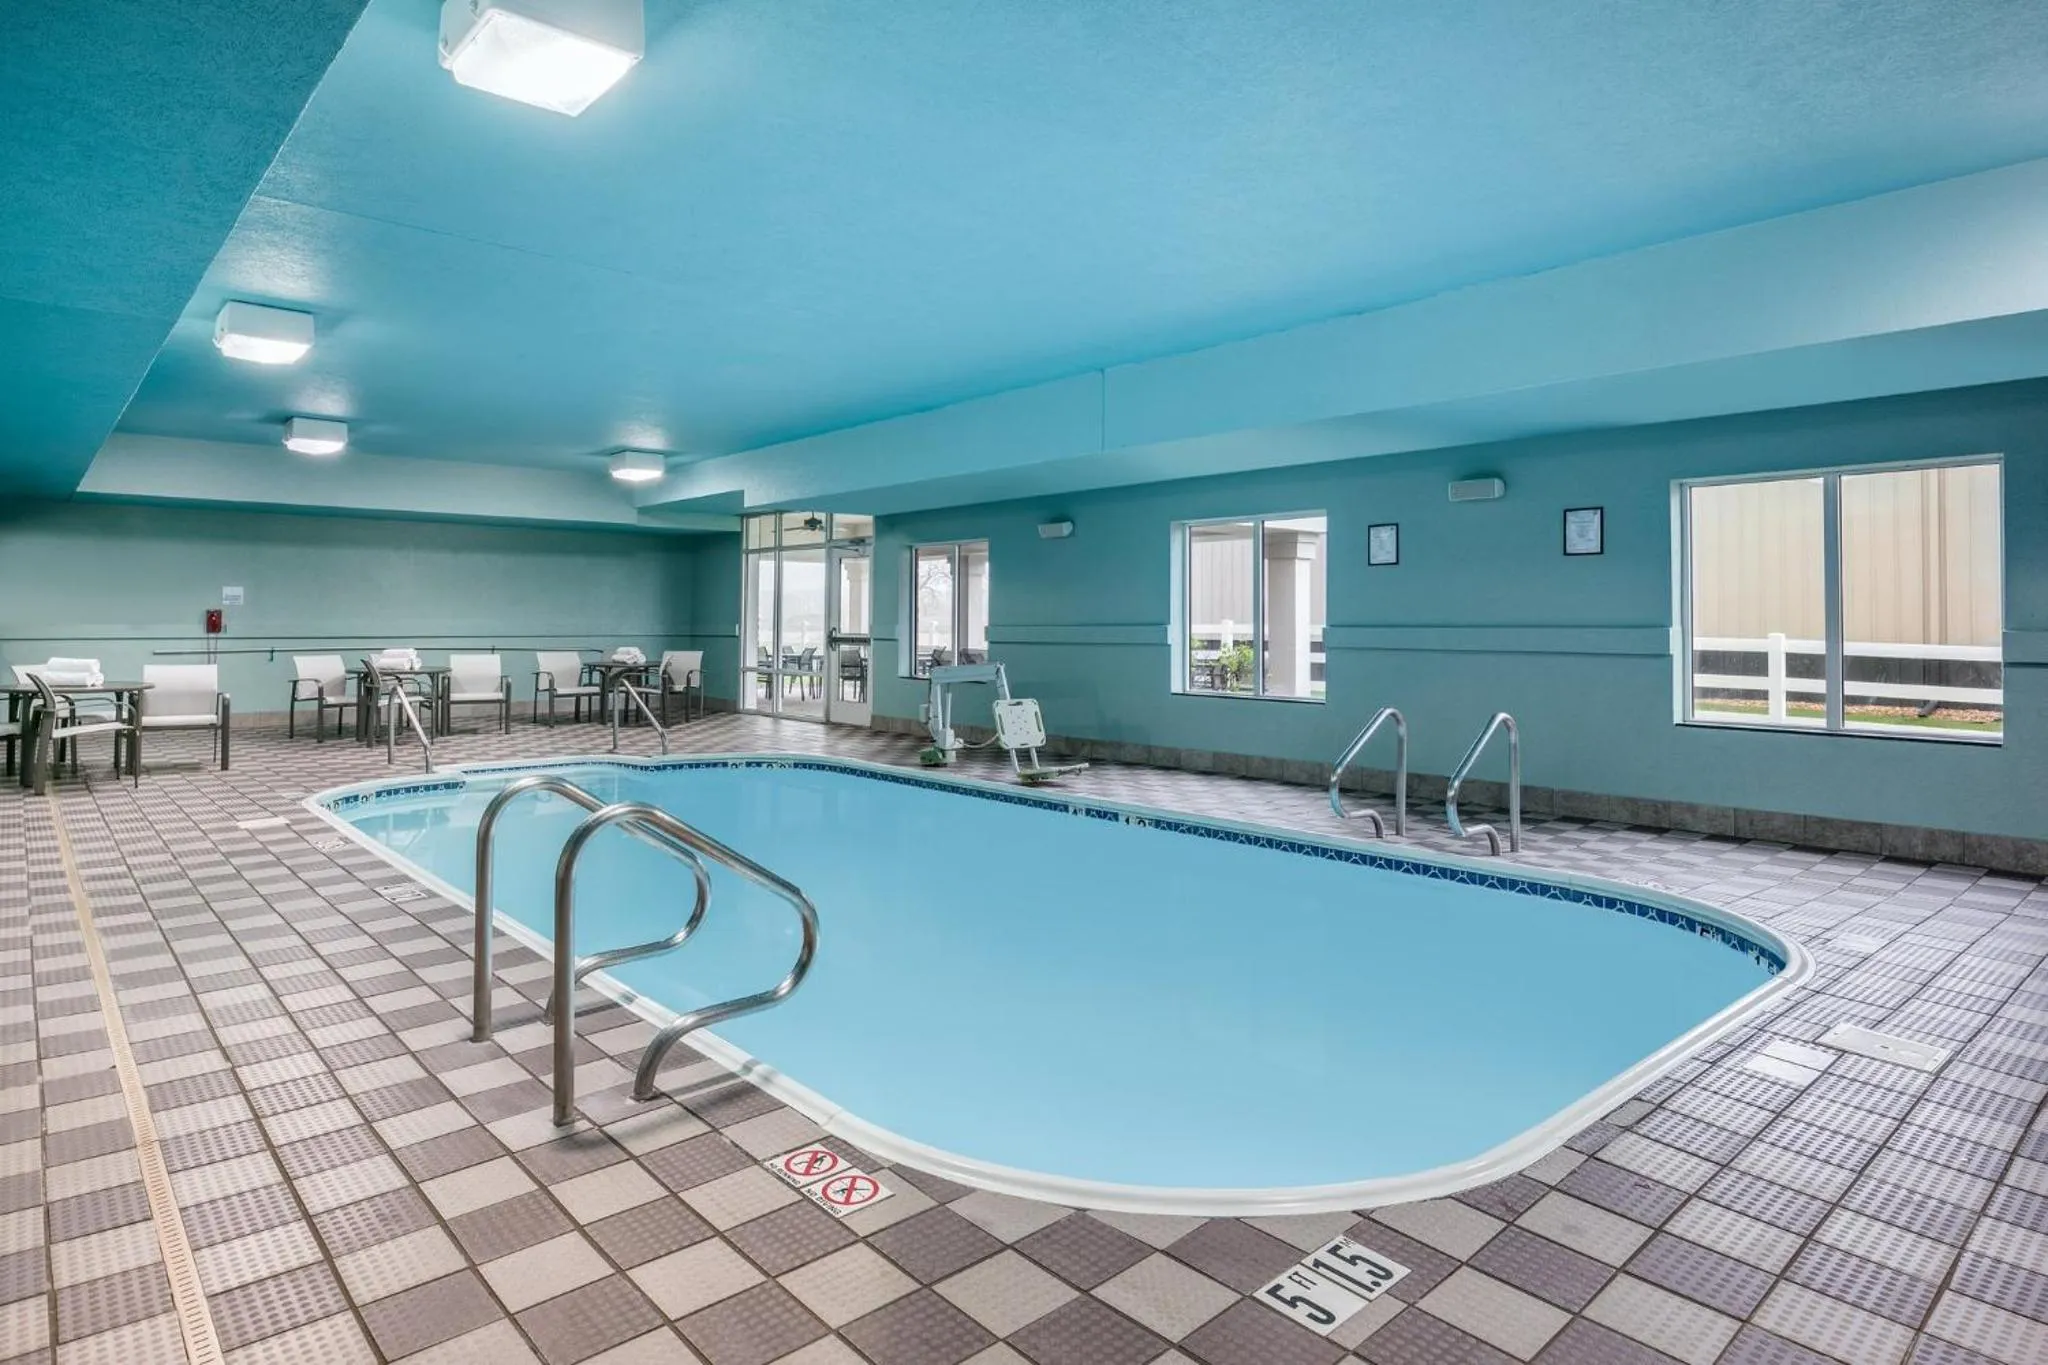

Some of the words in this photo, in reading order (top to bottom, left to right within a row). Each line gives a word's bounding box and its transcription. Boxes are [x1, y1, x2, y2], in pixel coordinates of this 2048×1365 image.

[1287, 1271, 1318, 1291] FT
[1312, 1244, 1394, 1293] 1.5
[1265, 1283, 1336, 1325] 5
